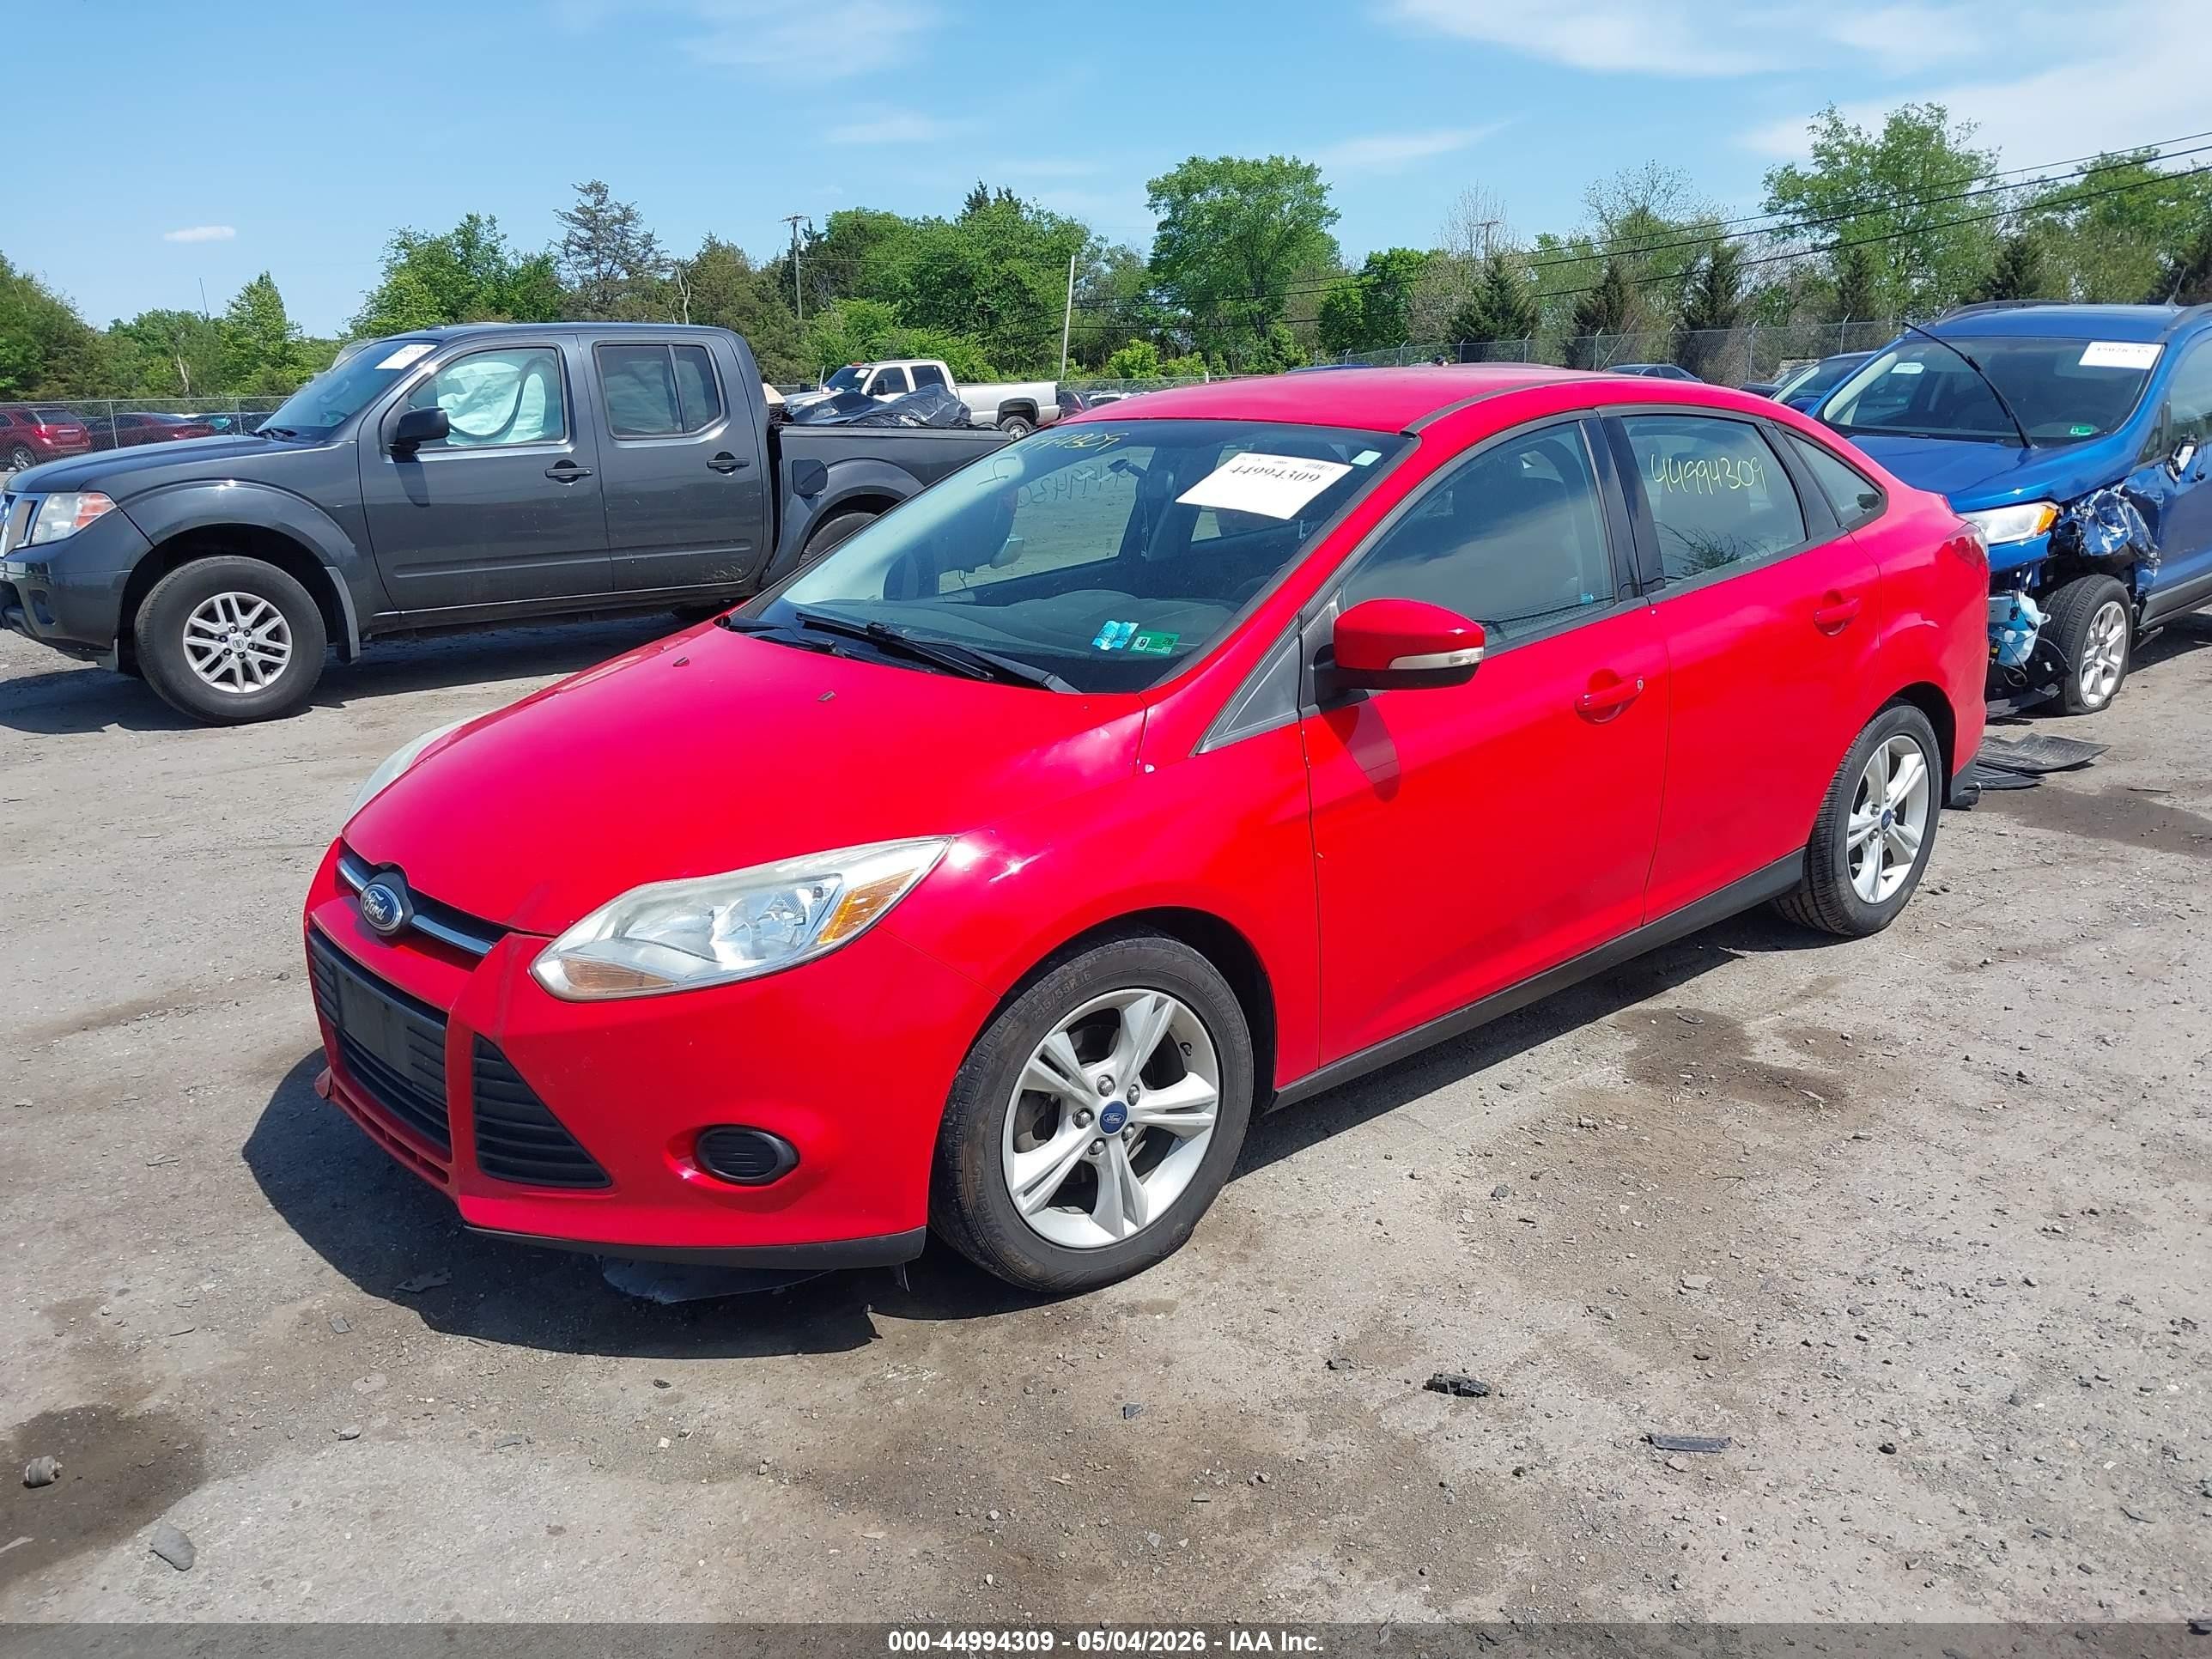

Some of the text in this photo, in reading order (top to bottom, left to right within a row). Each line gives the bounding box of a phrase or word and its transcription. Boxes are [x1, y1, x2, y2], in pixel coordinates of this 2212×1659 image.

[1230, 465, 1321, 482] 44994309
[1650, 453, 1767, 495] 44994309
[1139, 637, 1175, 647] 9 26
[364, 890, 388, 921] Ford
[1106, 1113, 1122, 1123] Ford
